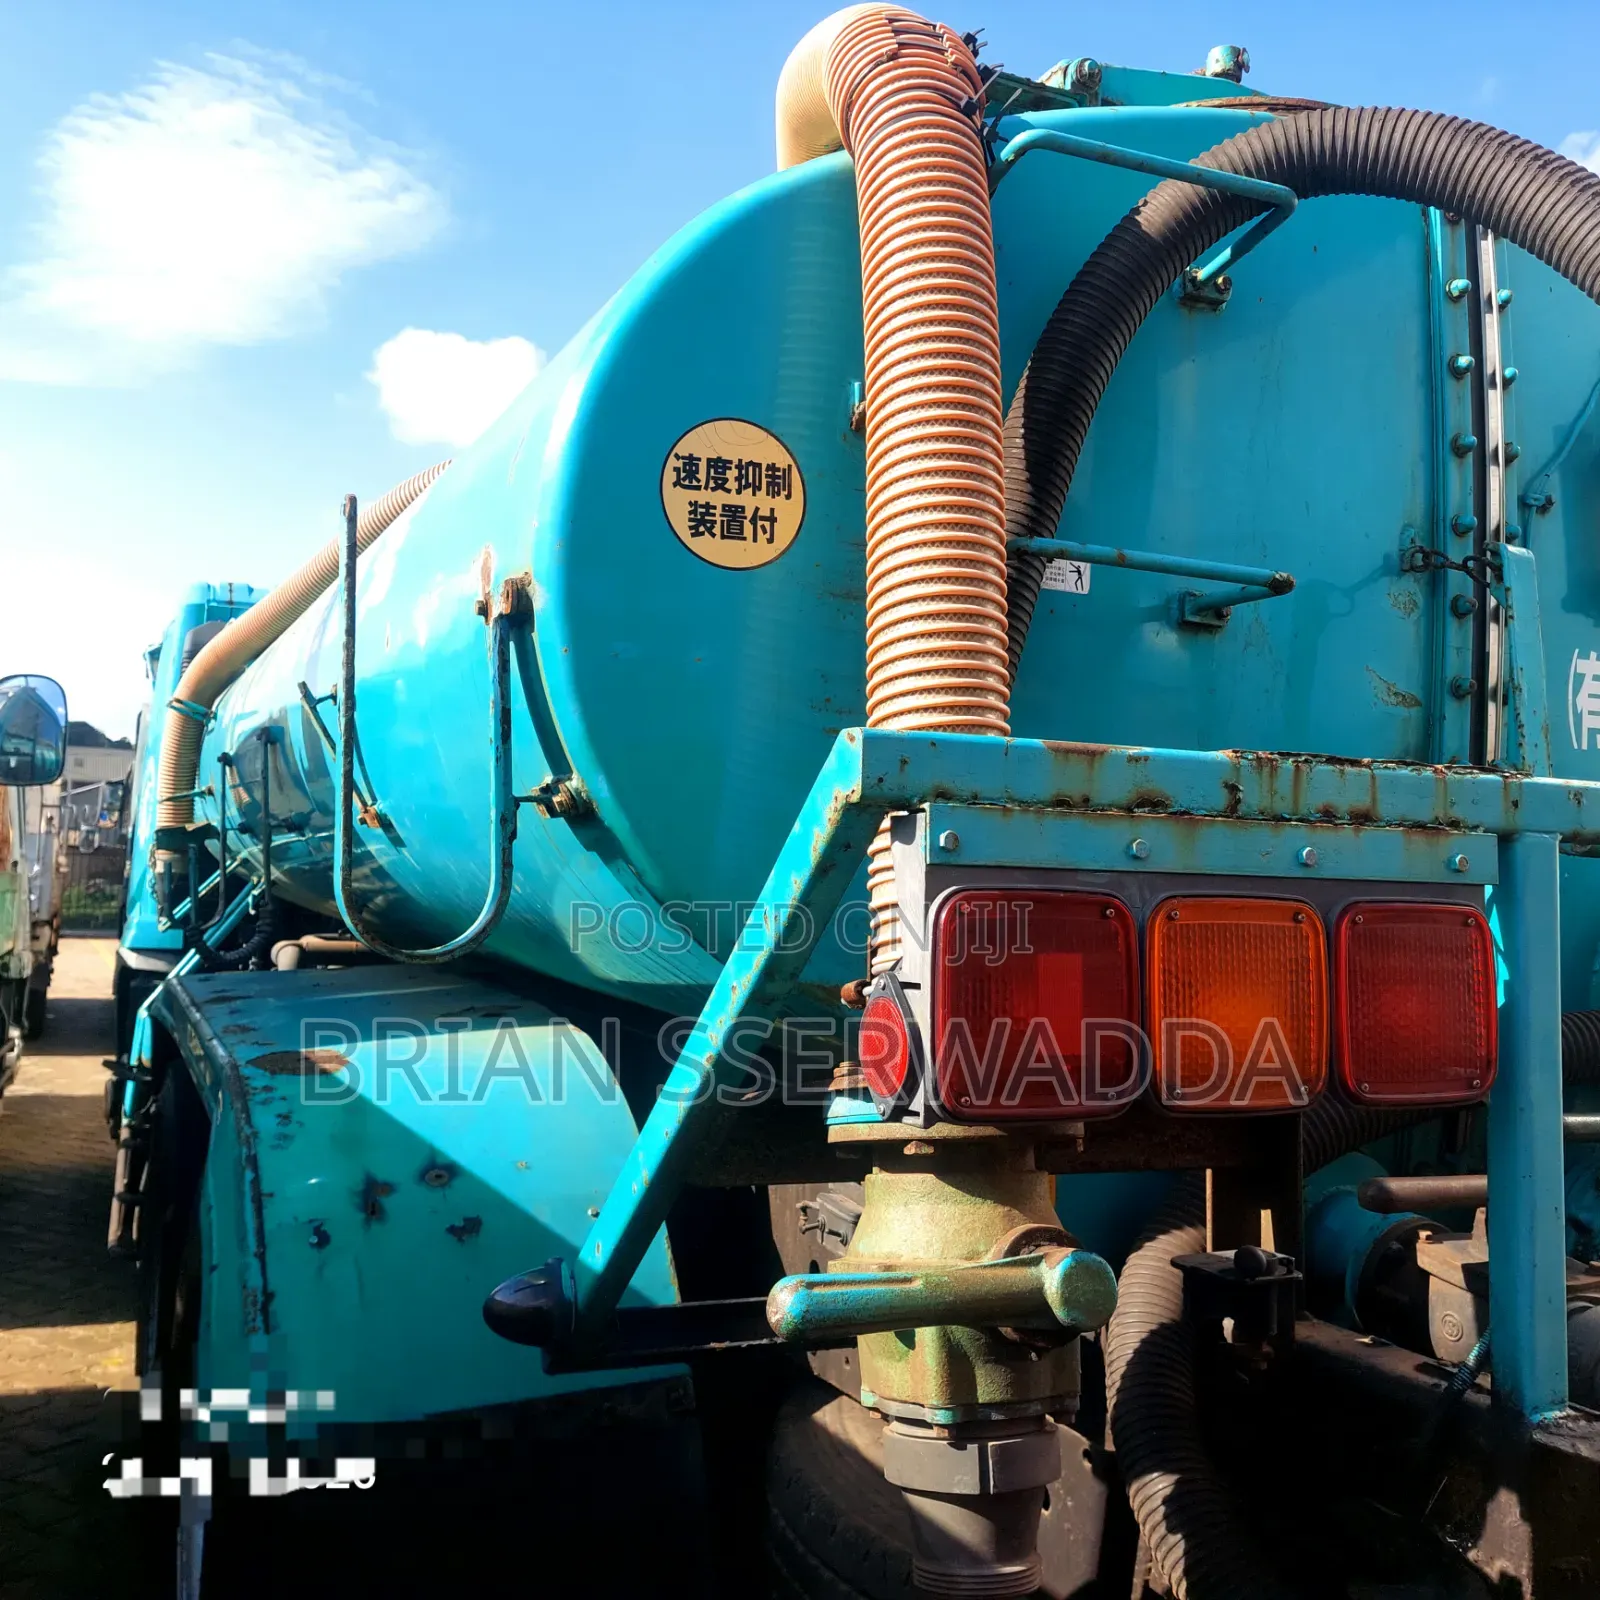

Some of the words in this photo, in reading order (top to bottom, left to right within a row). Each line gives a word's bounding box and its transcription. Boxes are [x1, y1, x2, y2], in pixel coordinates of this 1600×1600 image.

[672, 452, 793, 500] 速度抑制
[687, 500, 778, 544] 装置付
